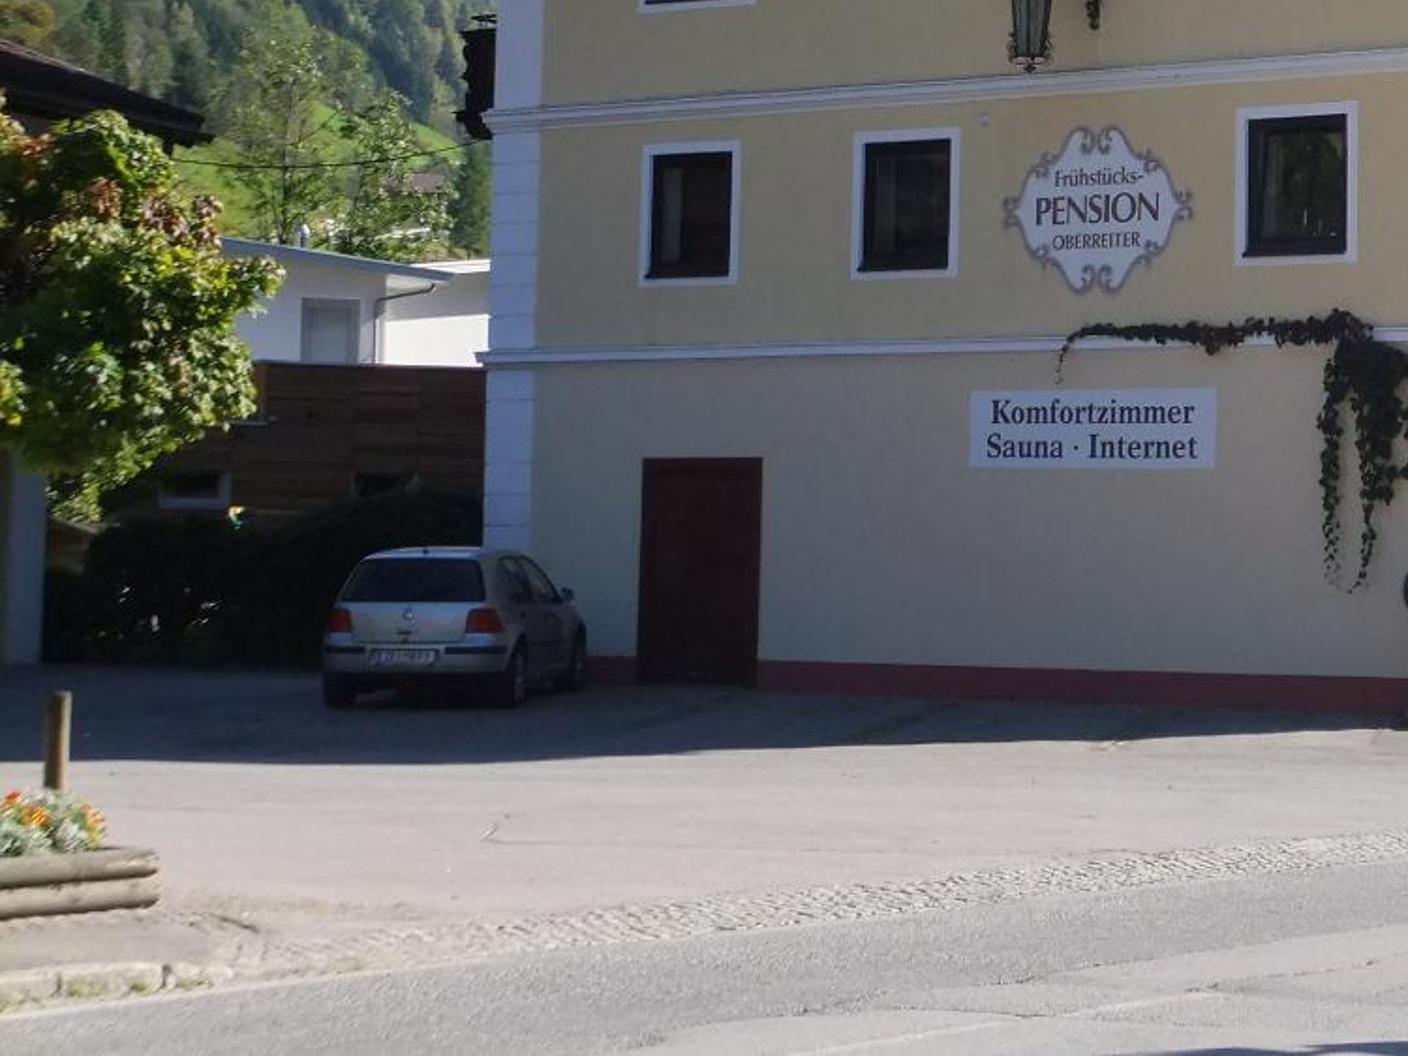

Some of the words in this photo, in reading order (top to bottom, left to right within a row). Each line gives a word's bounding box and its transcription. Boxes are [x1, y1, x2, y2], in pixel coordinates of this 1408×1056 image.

[1054, 167, 1143, 187] Frühstücks-
[1035, 192, 1160, 225] PENSION
[1052, 231, 1141, 251] OBERREITER
[991, 398, 1195, 424] Komfortzimmer
[987, 433, 1063, 459] Sauna
[1089, 433, 1198, 459] Internet
